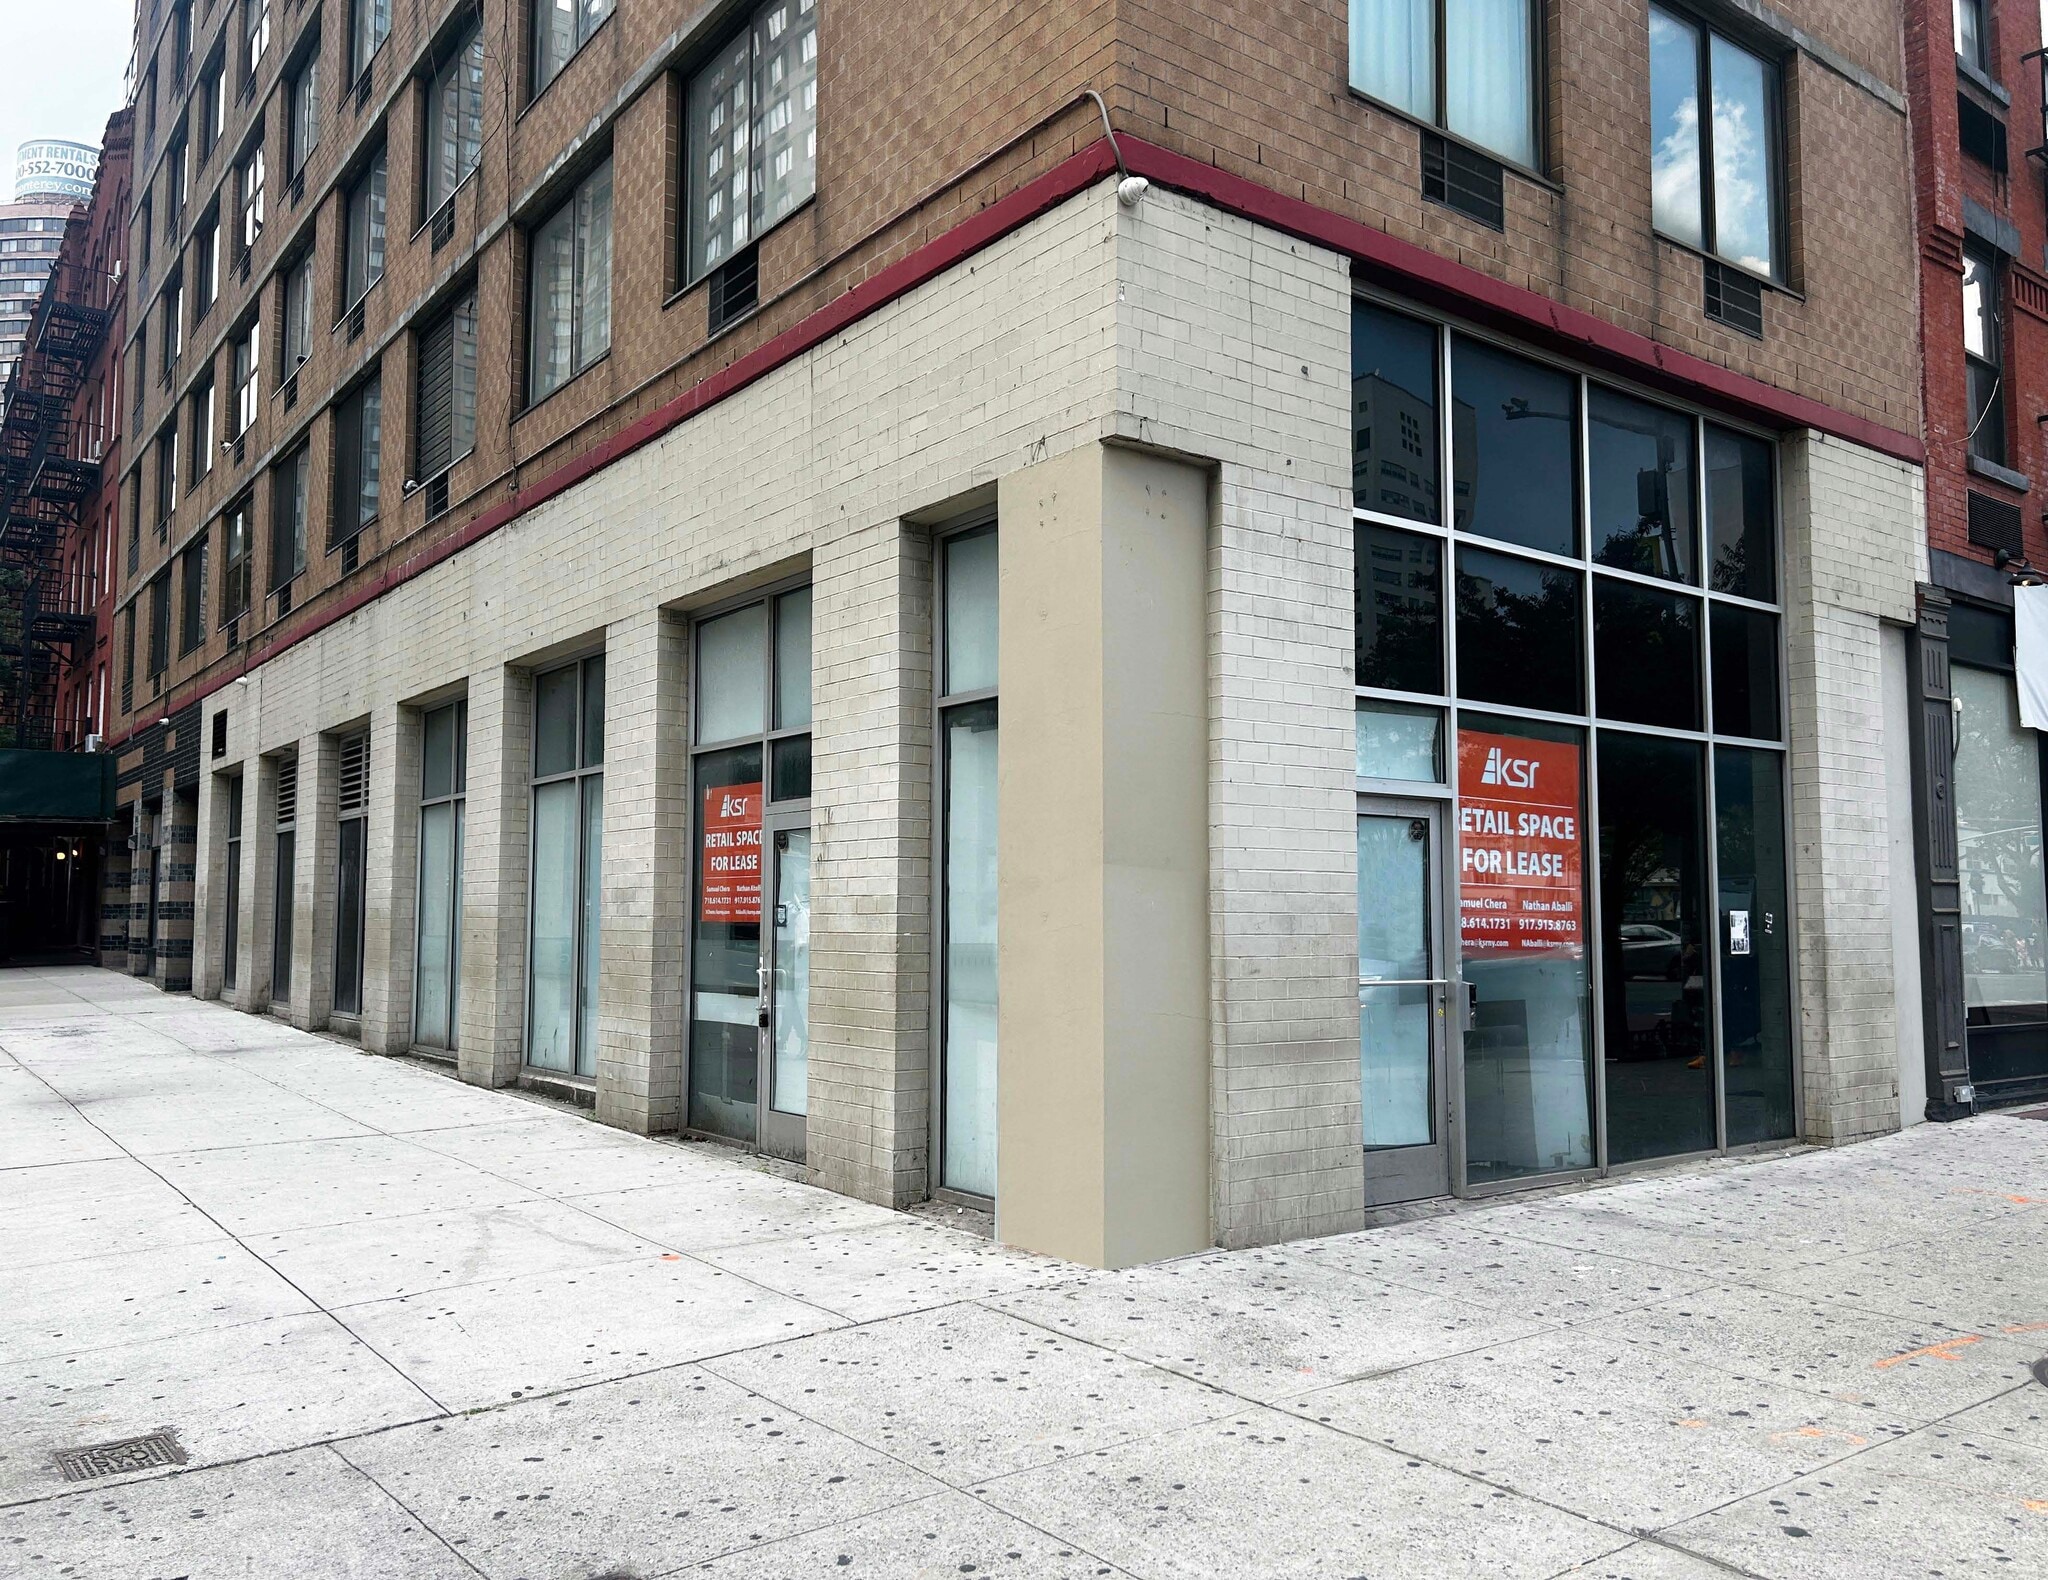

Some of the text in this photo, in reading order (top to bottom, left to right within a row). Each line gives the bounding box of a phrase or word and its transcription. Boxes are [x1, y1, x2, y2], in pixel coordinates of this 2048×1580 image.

[46, 146, 97, 166] RENTALS
[1459, 807, 1575, 840] ETAIL SPACE
[705, 832, 734, 848] RETAIL
[711, 855, 758, 872] FOR LEASE
[1462, 848, 1563, 877] FOR LEASE
[1485, 898, 1508, 909] Chera
[1523, 900, 1573, 912] Nathan Aballi
[1519, 918, 1576, 931] 917.915.8763
